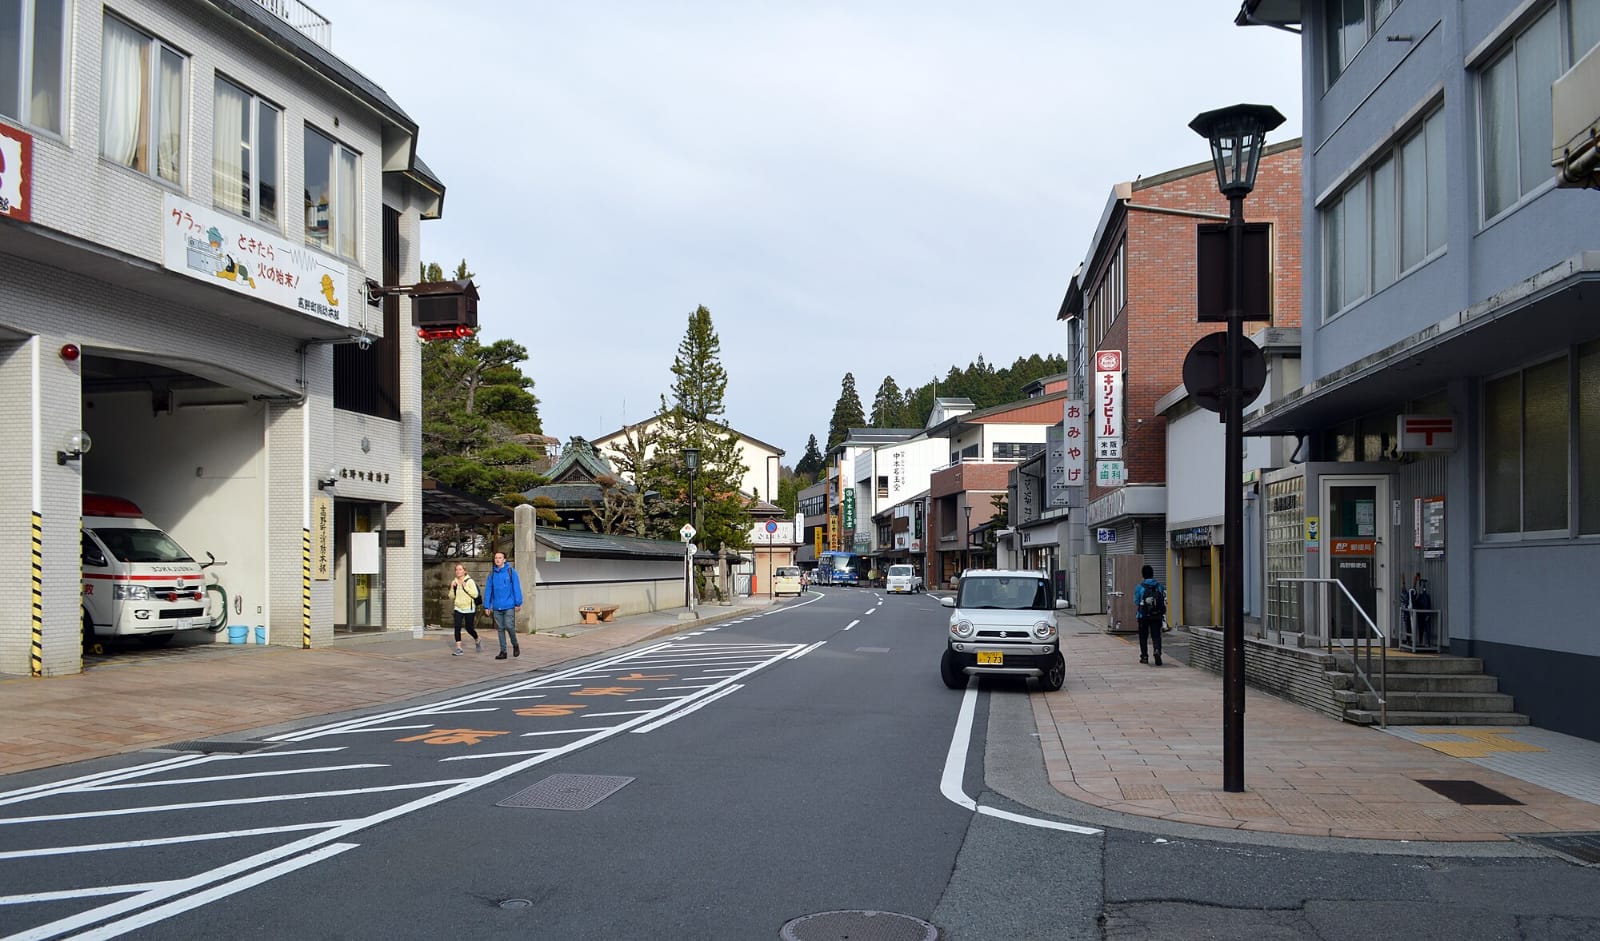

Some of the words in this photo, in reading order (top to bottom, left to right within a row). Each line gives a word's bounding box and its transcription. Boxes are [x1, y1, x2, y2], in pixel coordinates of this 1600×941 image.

[238, 233, 275, 261] ときたら
[1103, 373, 1115, 436] キリンビール
[1067, 405, 1081, 481] おみやげ
[1099, 529, 1116, 542] 地酒
